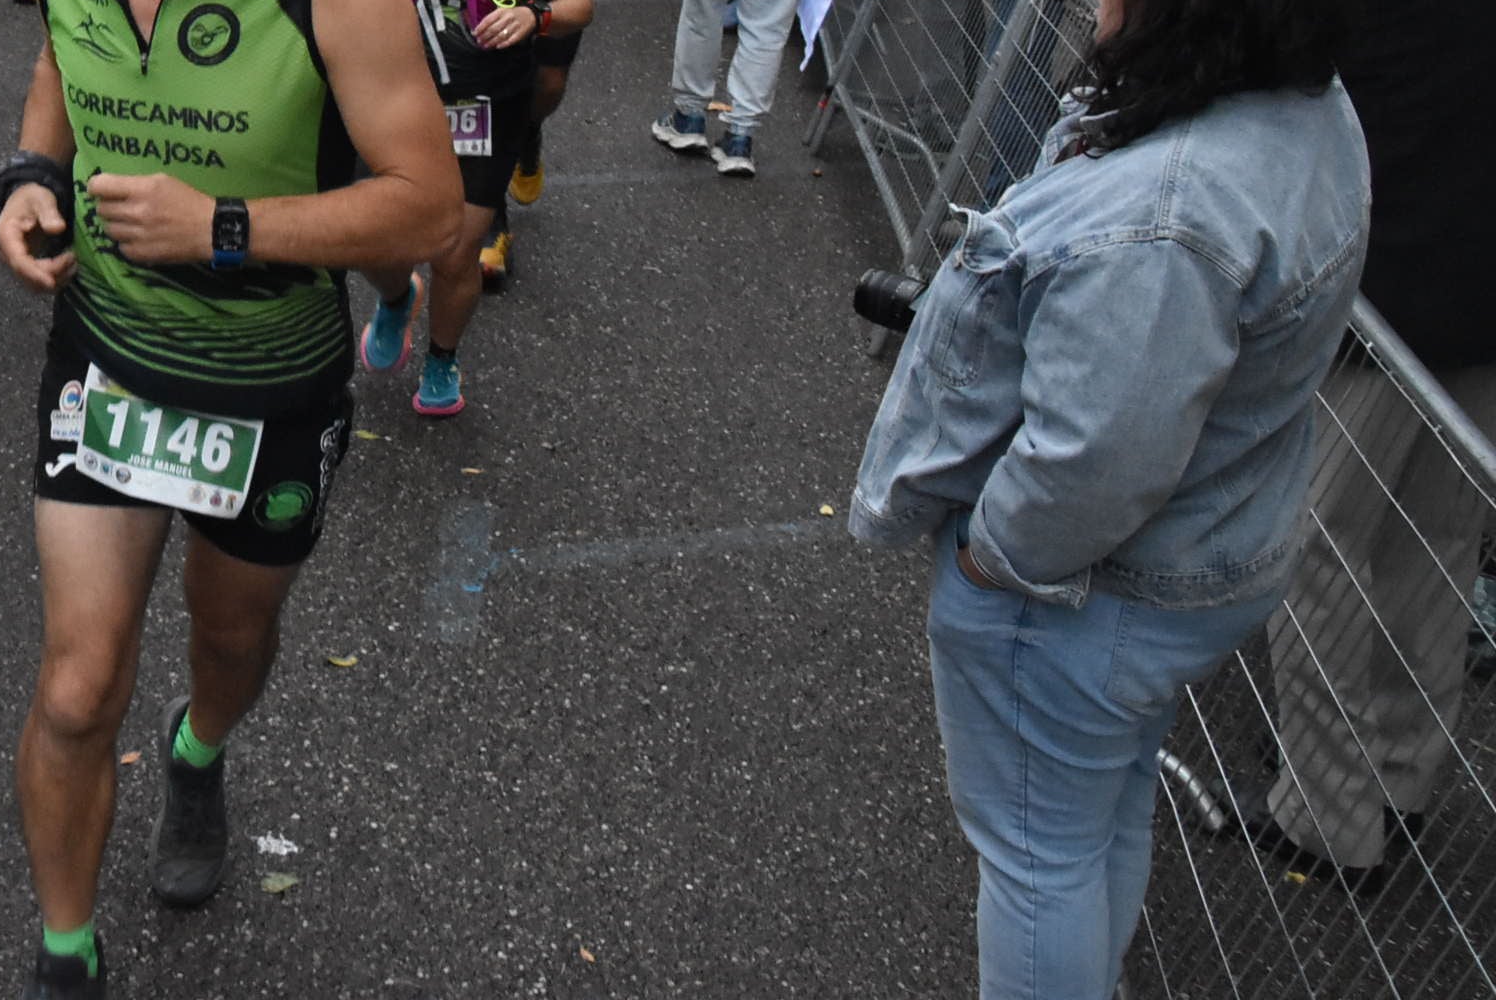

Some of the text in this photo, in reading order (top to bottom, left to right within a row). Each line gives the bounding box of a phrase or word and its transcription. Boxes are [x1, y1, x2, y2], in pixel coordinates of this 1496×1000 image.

[67, 83, 250, 133] CORRECAMINOS
[82, 124, 226, 169] CARBAJOSA
[106, 399, 235, 474] 1146
[154, 458, 193, 479] MANUEL
